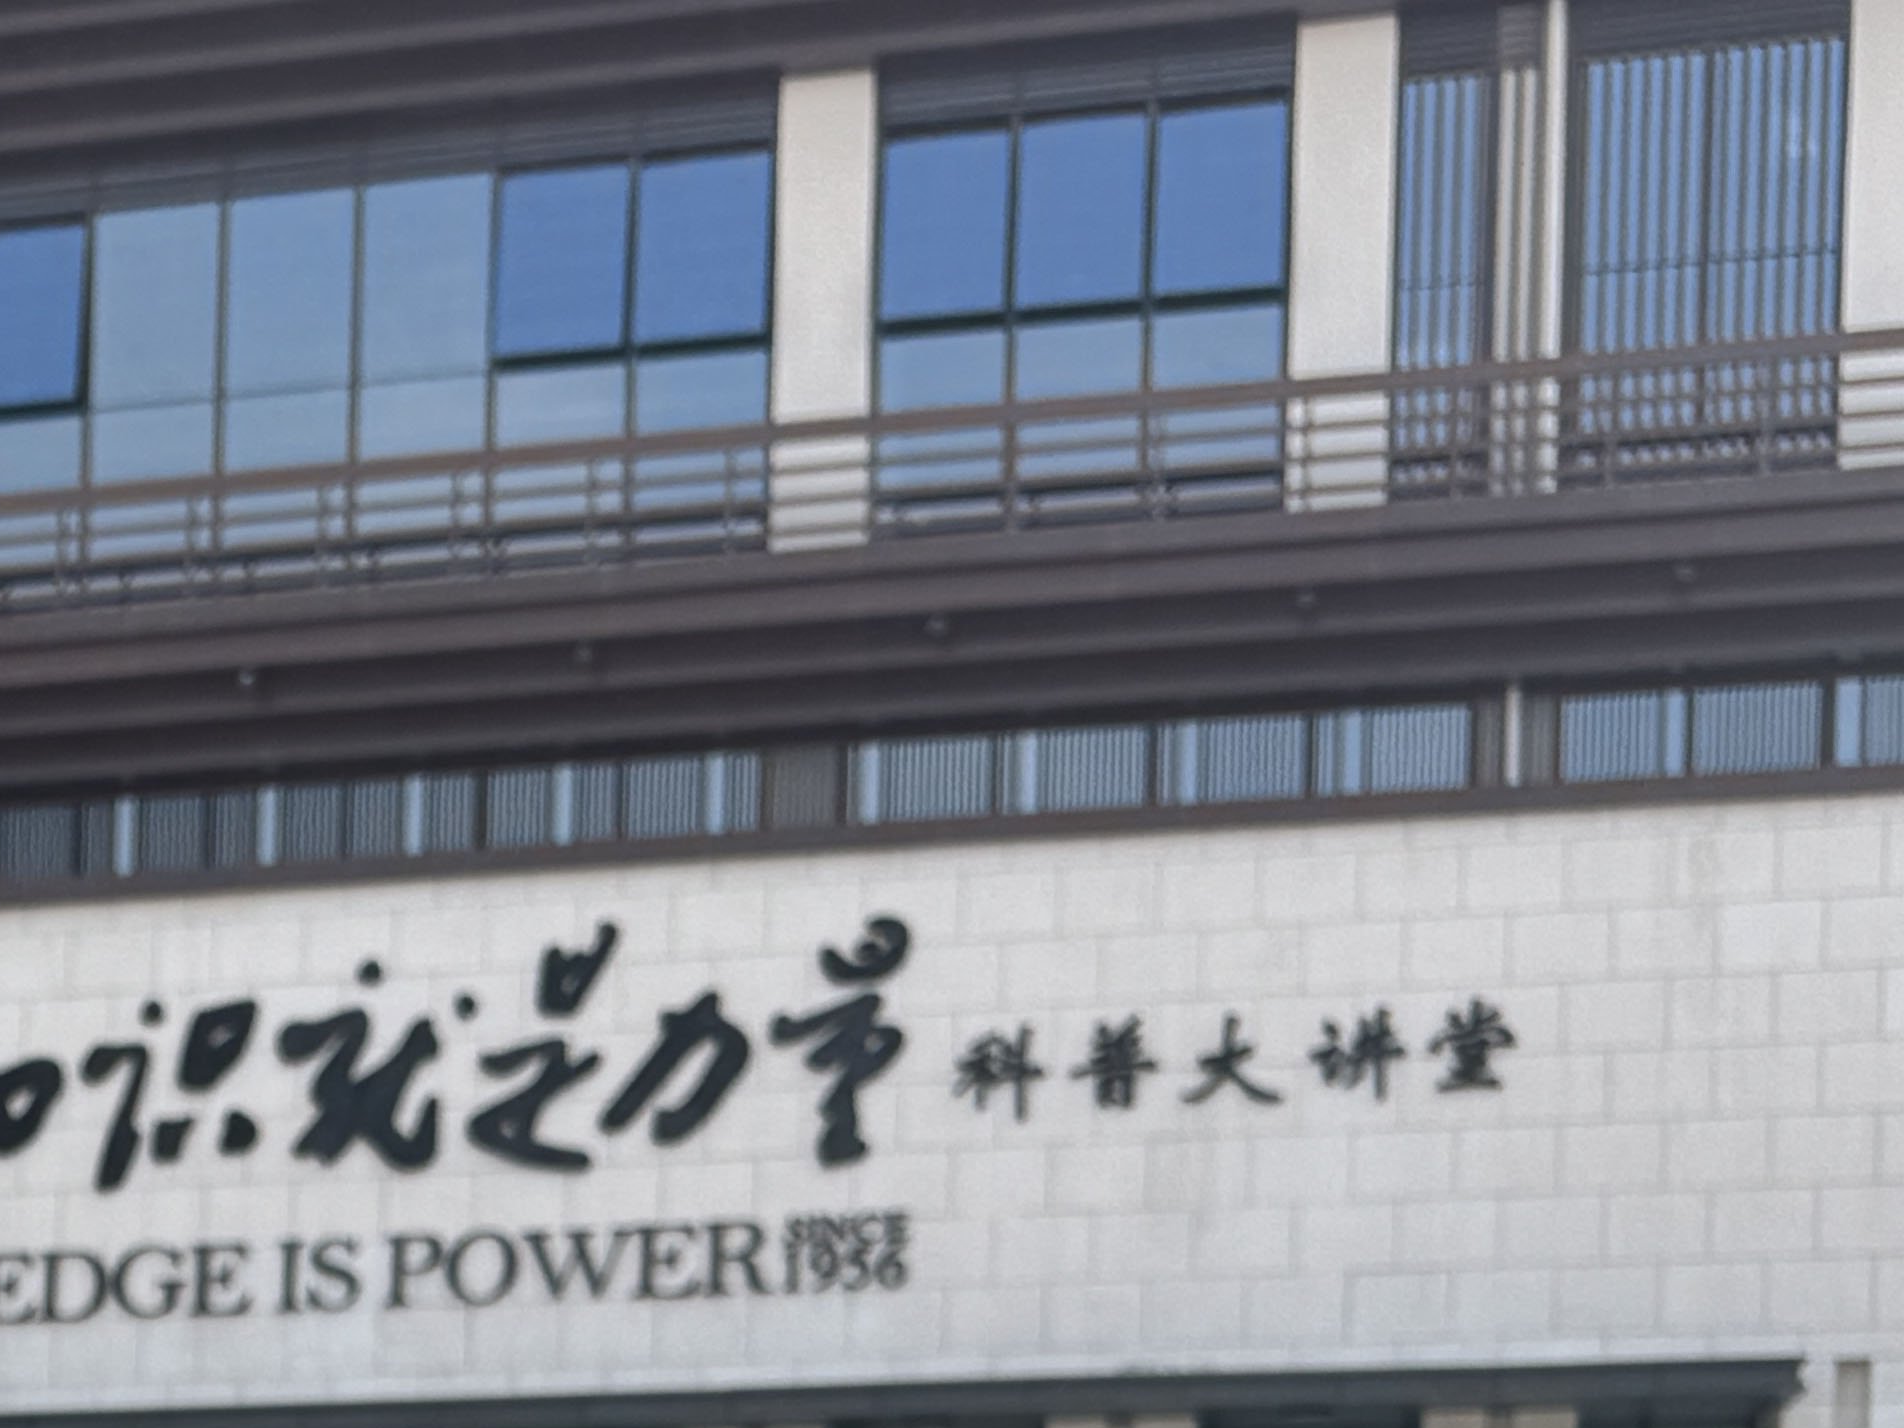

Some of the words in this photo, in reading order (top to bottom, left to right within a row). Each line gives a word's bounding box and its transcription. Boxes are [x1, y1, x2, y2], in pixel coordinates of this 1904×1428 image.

[952, 998, 1518, 1121] 科普大讲堂
[280, 1236, 360, 1314] IS
[387, 1221, 772, 1308] POWER
